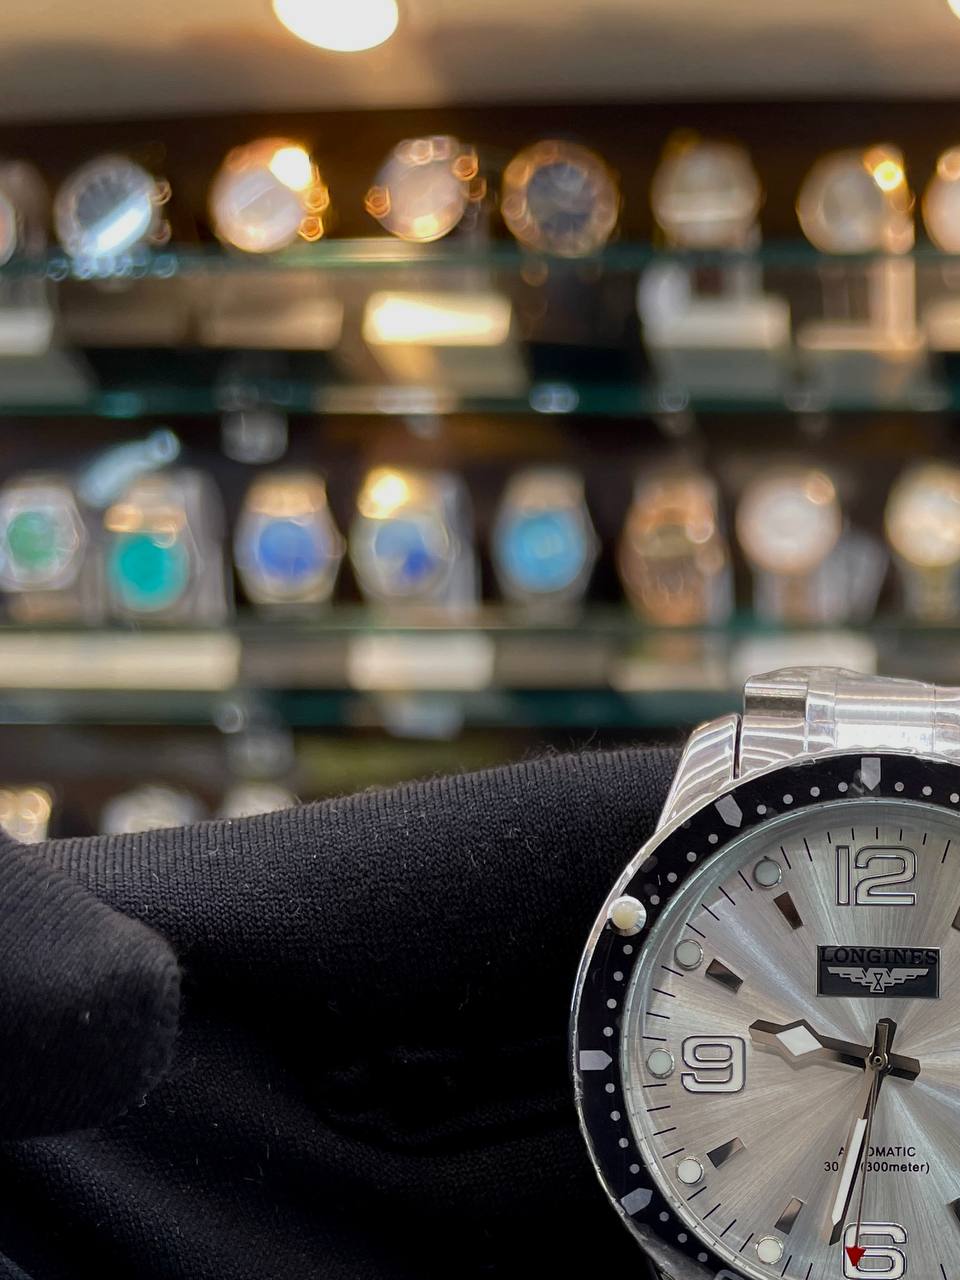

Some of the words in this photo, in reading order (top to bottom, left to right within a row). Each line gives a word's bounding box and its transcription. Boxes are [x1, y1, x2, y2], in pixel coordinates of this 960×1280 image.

[836, 845, 917, 906] 12
[820, 948, 938, 965] LONGINES
[681, 1035, 746, 1093] 9
[838, 1146, 916, 1157] AOMATIC
[842, 1222, 907, 1280] 6
